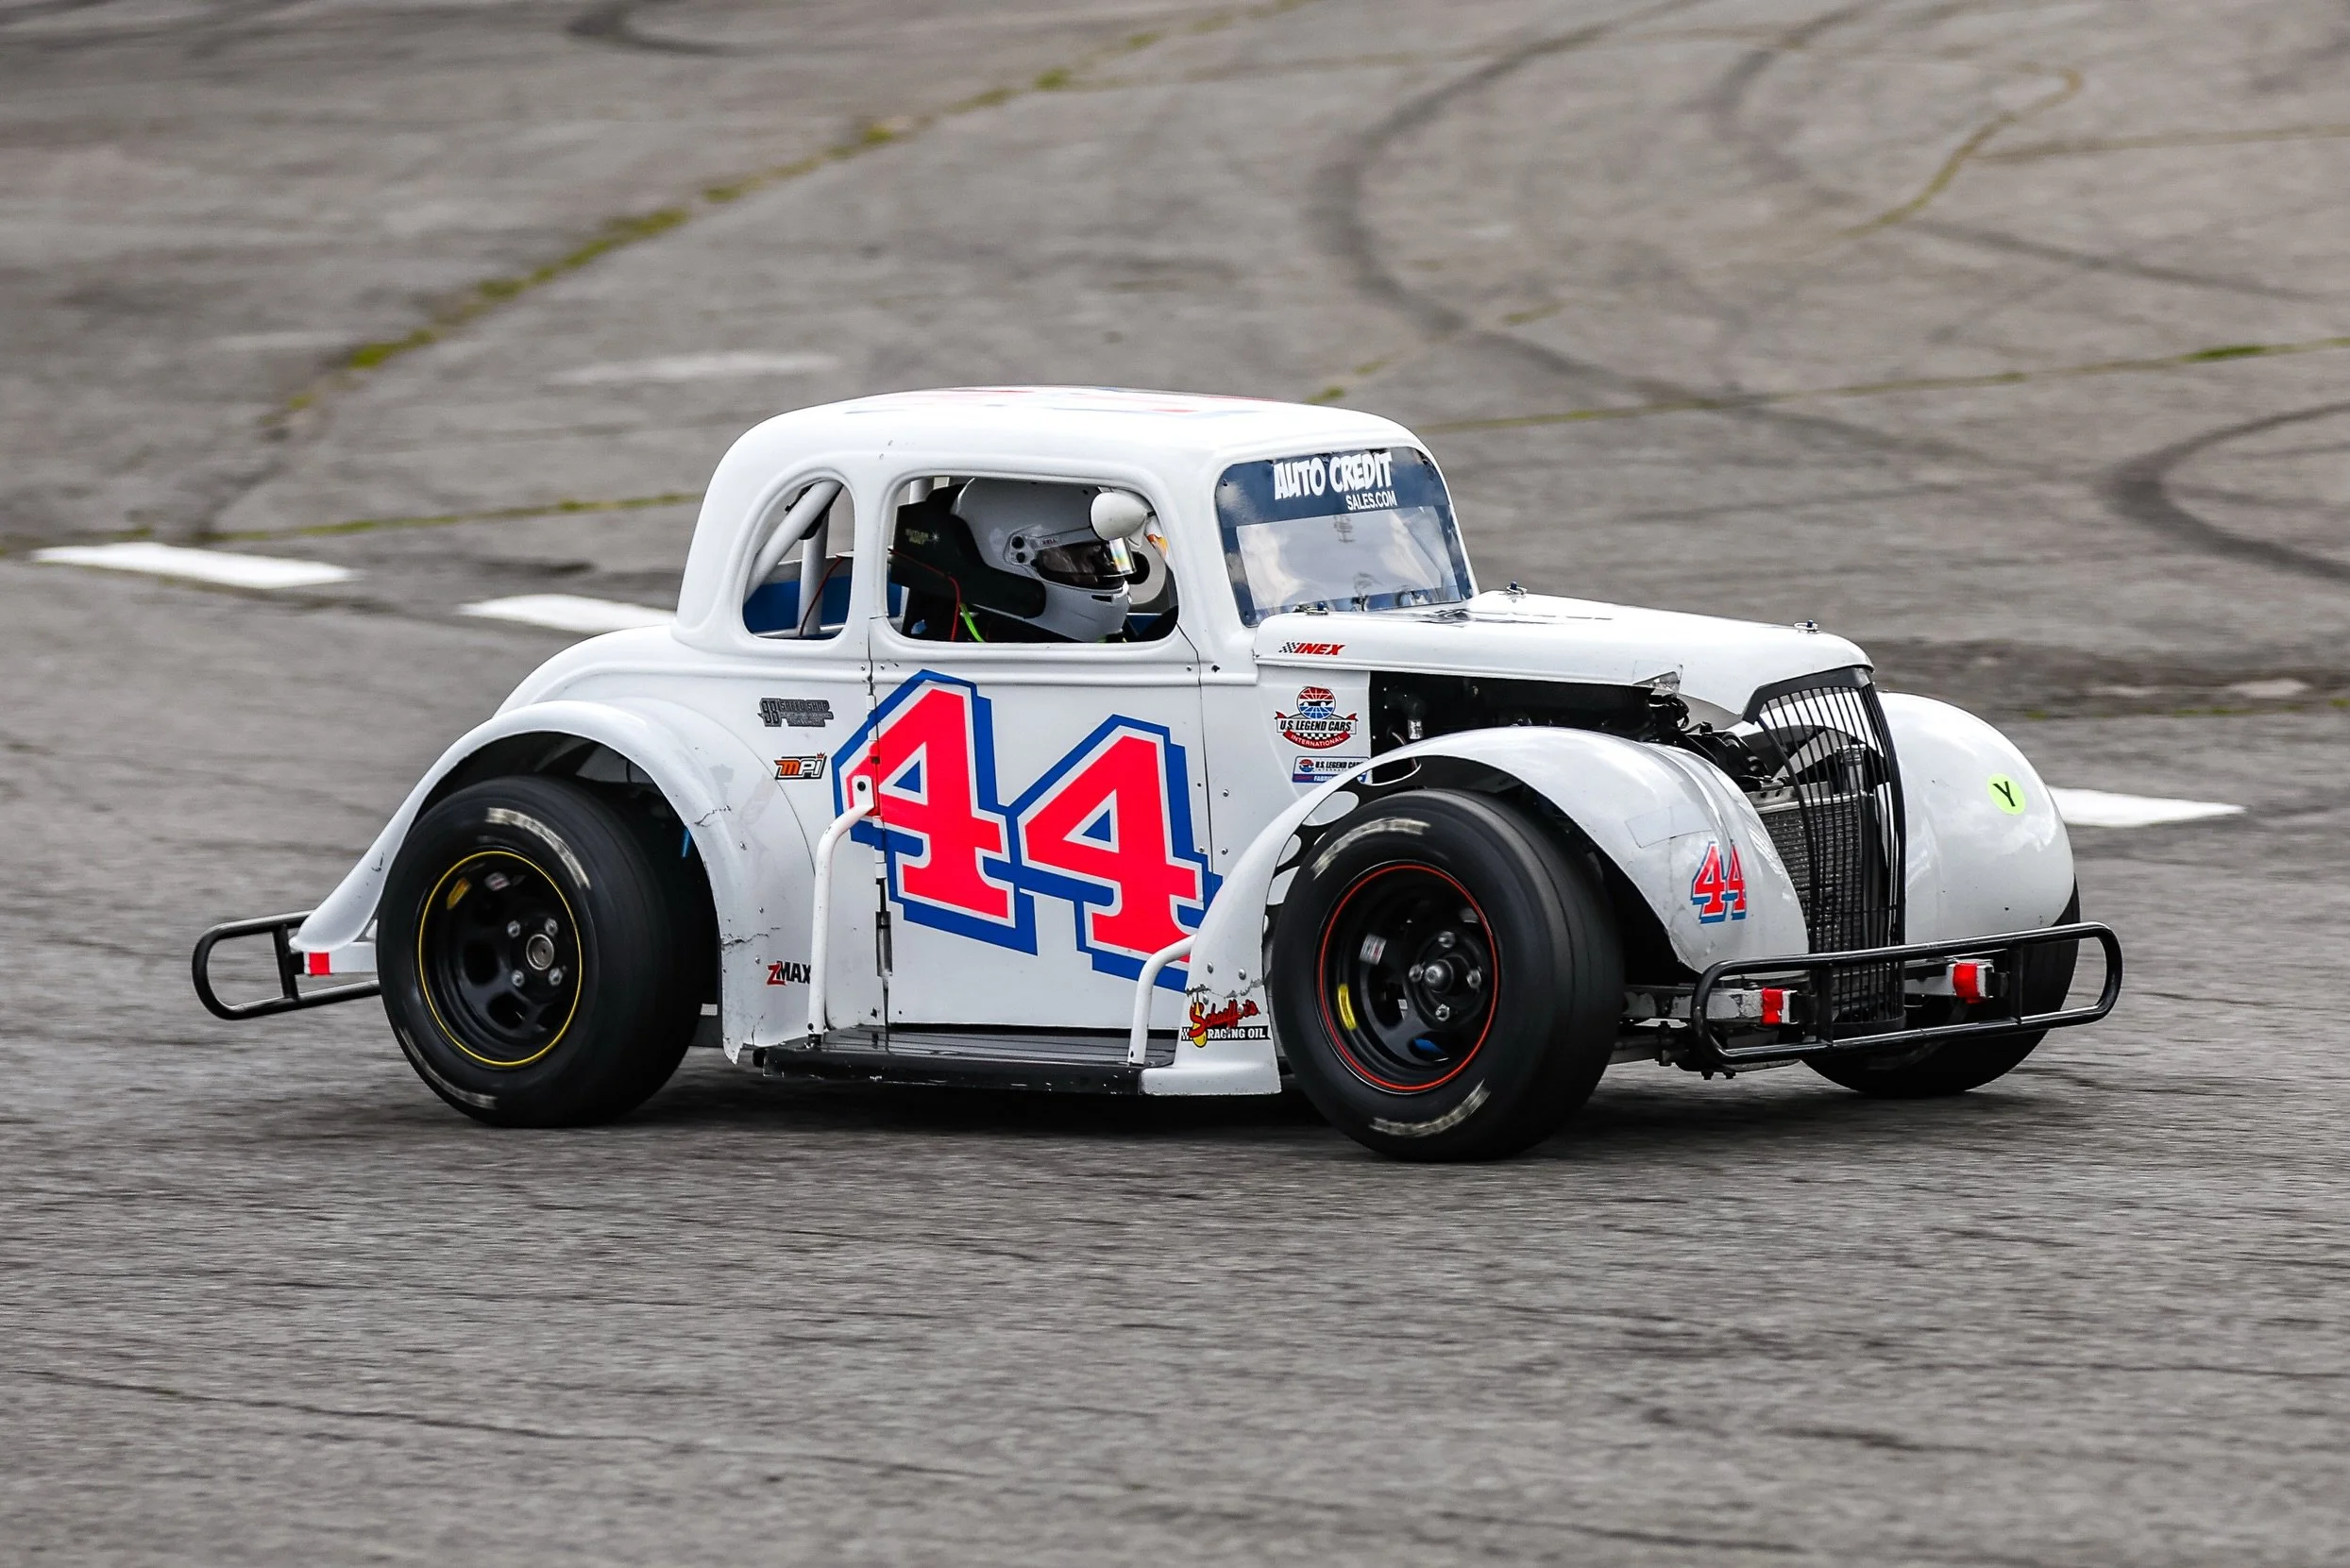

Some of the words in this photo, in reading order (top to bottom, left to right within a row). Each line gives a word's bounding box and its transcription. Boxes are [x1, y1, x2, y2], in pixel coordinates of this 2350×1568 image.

[1275, 458, 1326, 500] AUTO
[1328, 451, 1393, 493] CREDIT
[1345, 490, 1397, 511] SALES.COM
[1293, 643, 1345, 655] INEX
[806, 701, 828, 712] SHOP
[1279, 719, 1293, 731] U.S.
[1295, 719, 1327, 732] LEGEND
[1327, 721, 1352, 733] CARS
[1291, 733, 1344, 748] INTERNATIONAL
[1992, 781, 2016, 807] Y
[831, 669, 1224, 993] 44
[1690, 841, 1747, 924] 44
[766, 960, 811, 986] ZMAX
[1207, 1028, 1246, 1039] RACING
[1247, 1027, 1266, 1039] OIL
